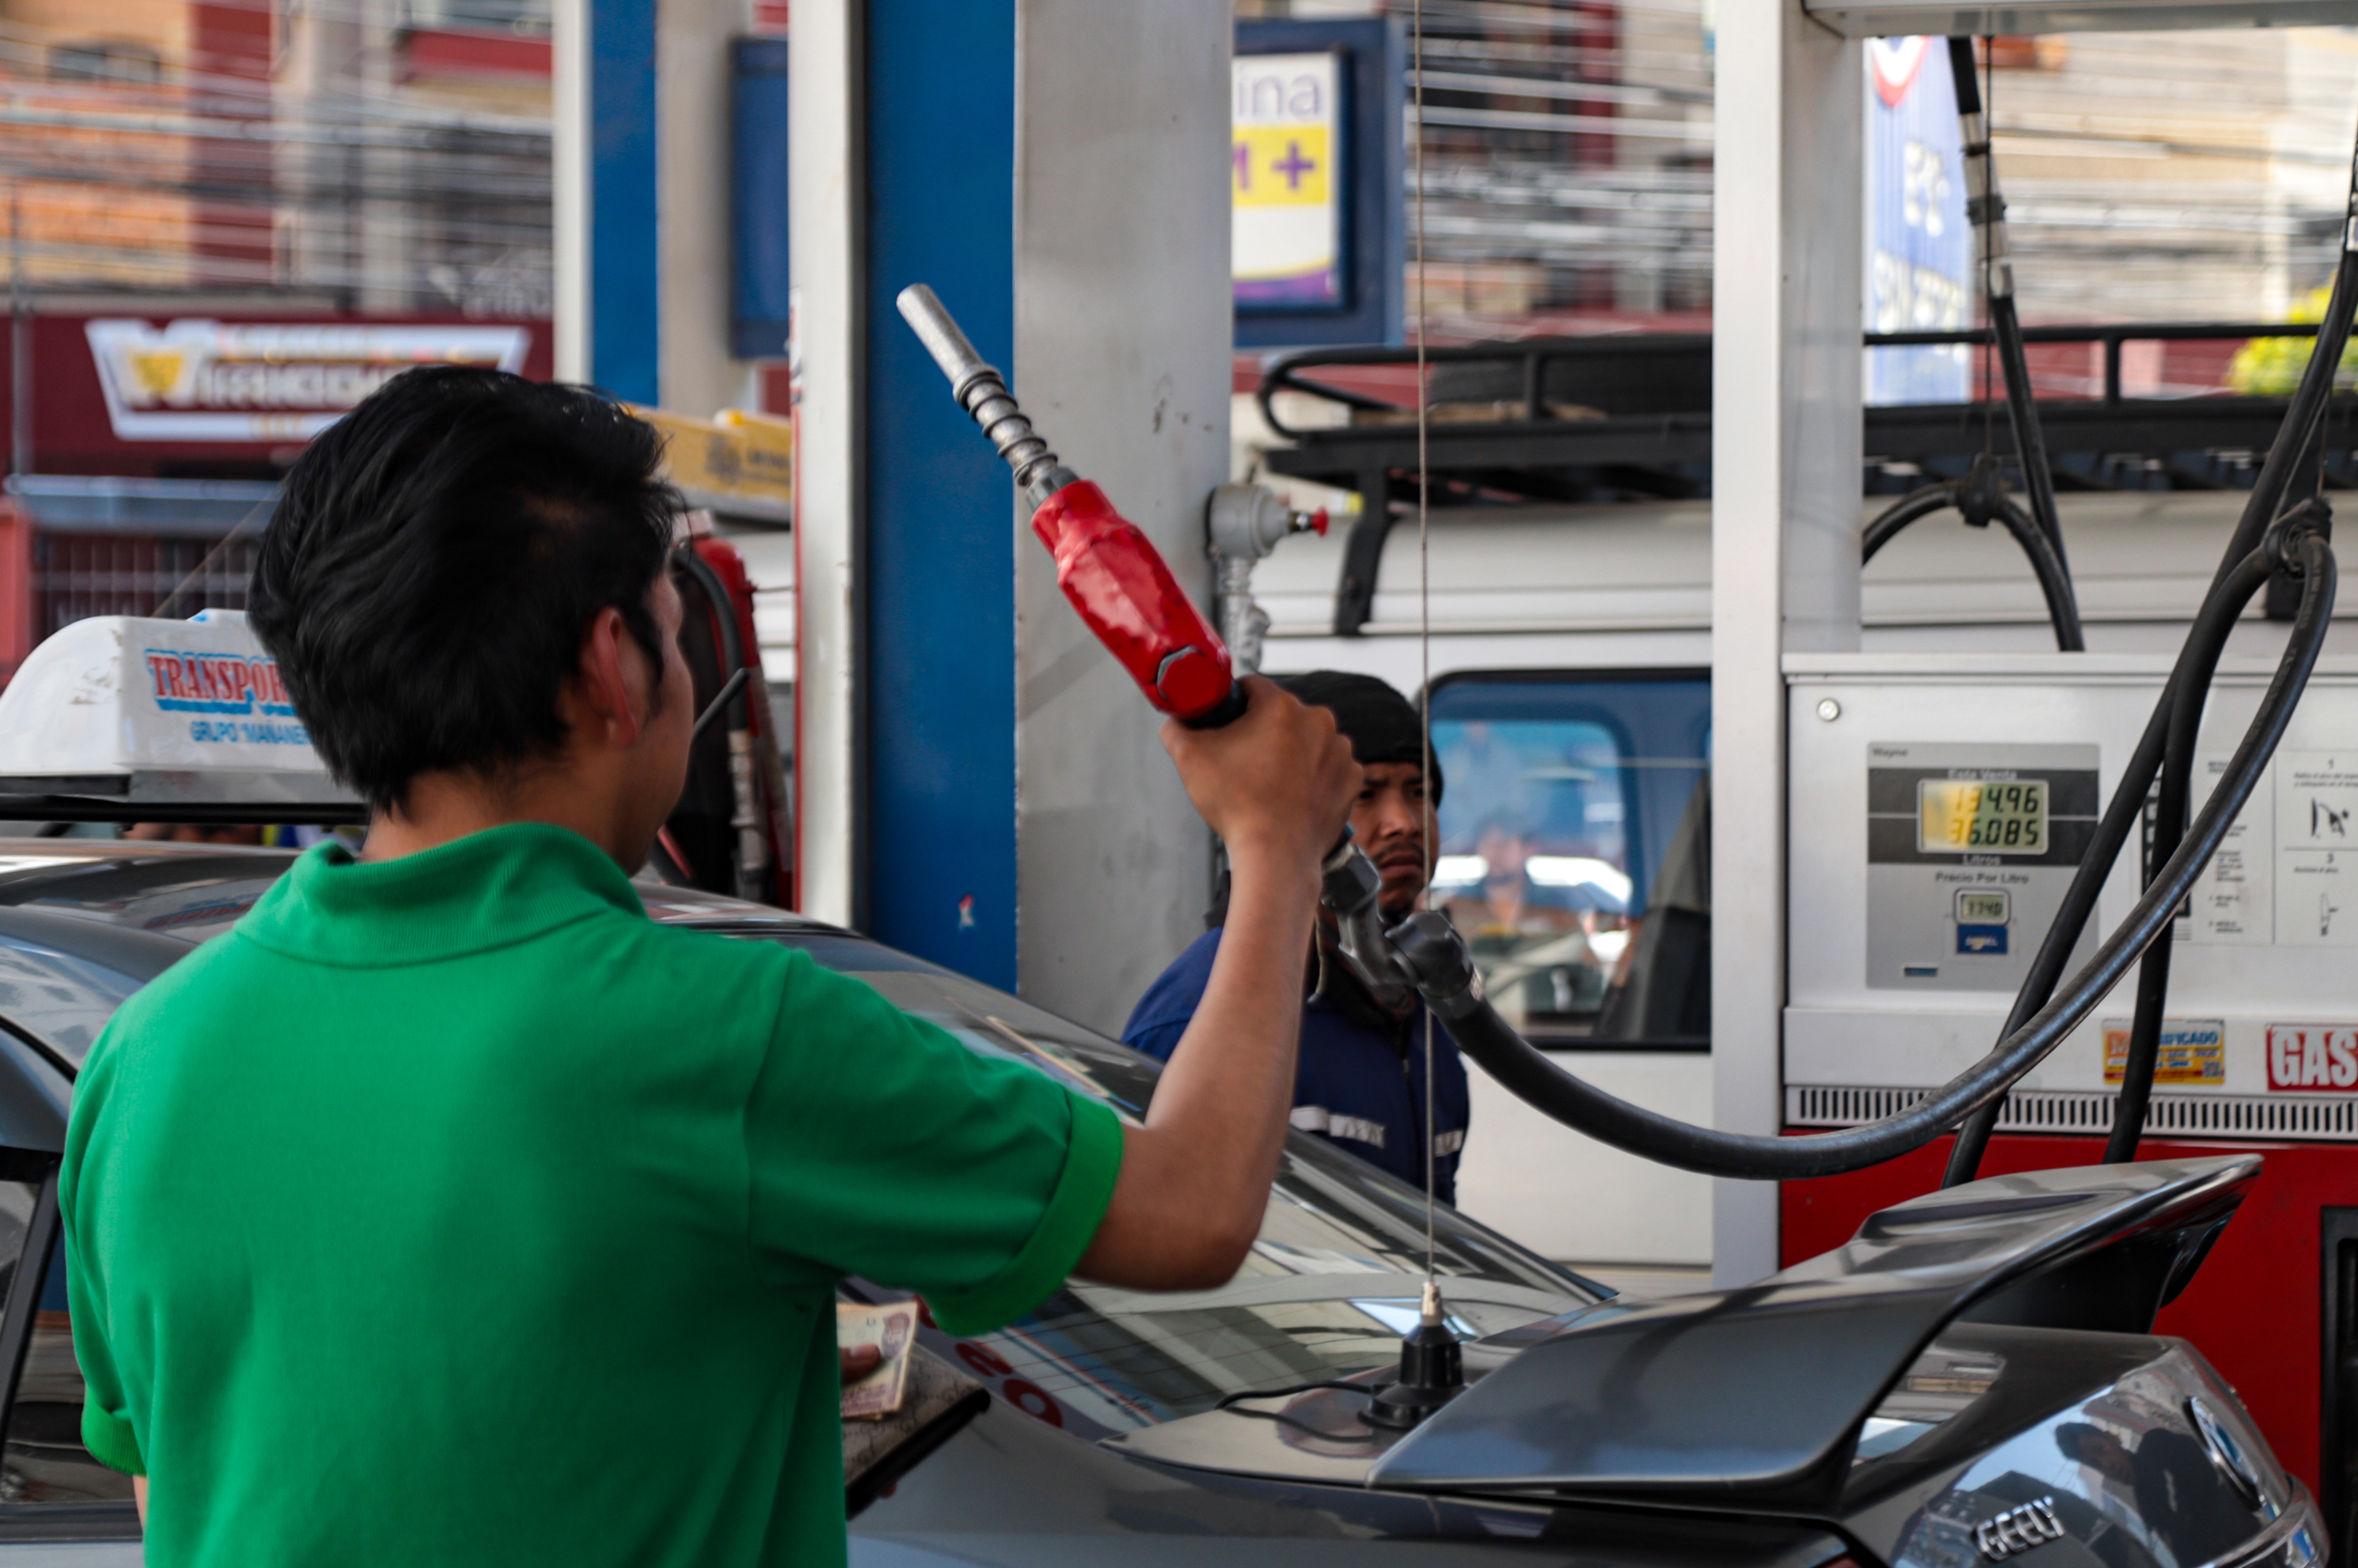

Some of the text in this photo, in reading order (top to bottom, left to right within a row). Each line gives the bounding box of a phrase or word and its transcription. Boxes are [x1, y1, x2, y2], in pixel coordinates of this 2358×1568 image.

[190, 721, 238, 742] GRUPO
[1950, 819, 2039, 846] 36.085
[1962, 854, 2001, 866] Litros
[1936, 872, 2029, 884] Precio Por Litro
[2272, 1028, 2358, 1087] GAS
[1977, 1495, 2065, 1561] GEELY
